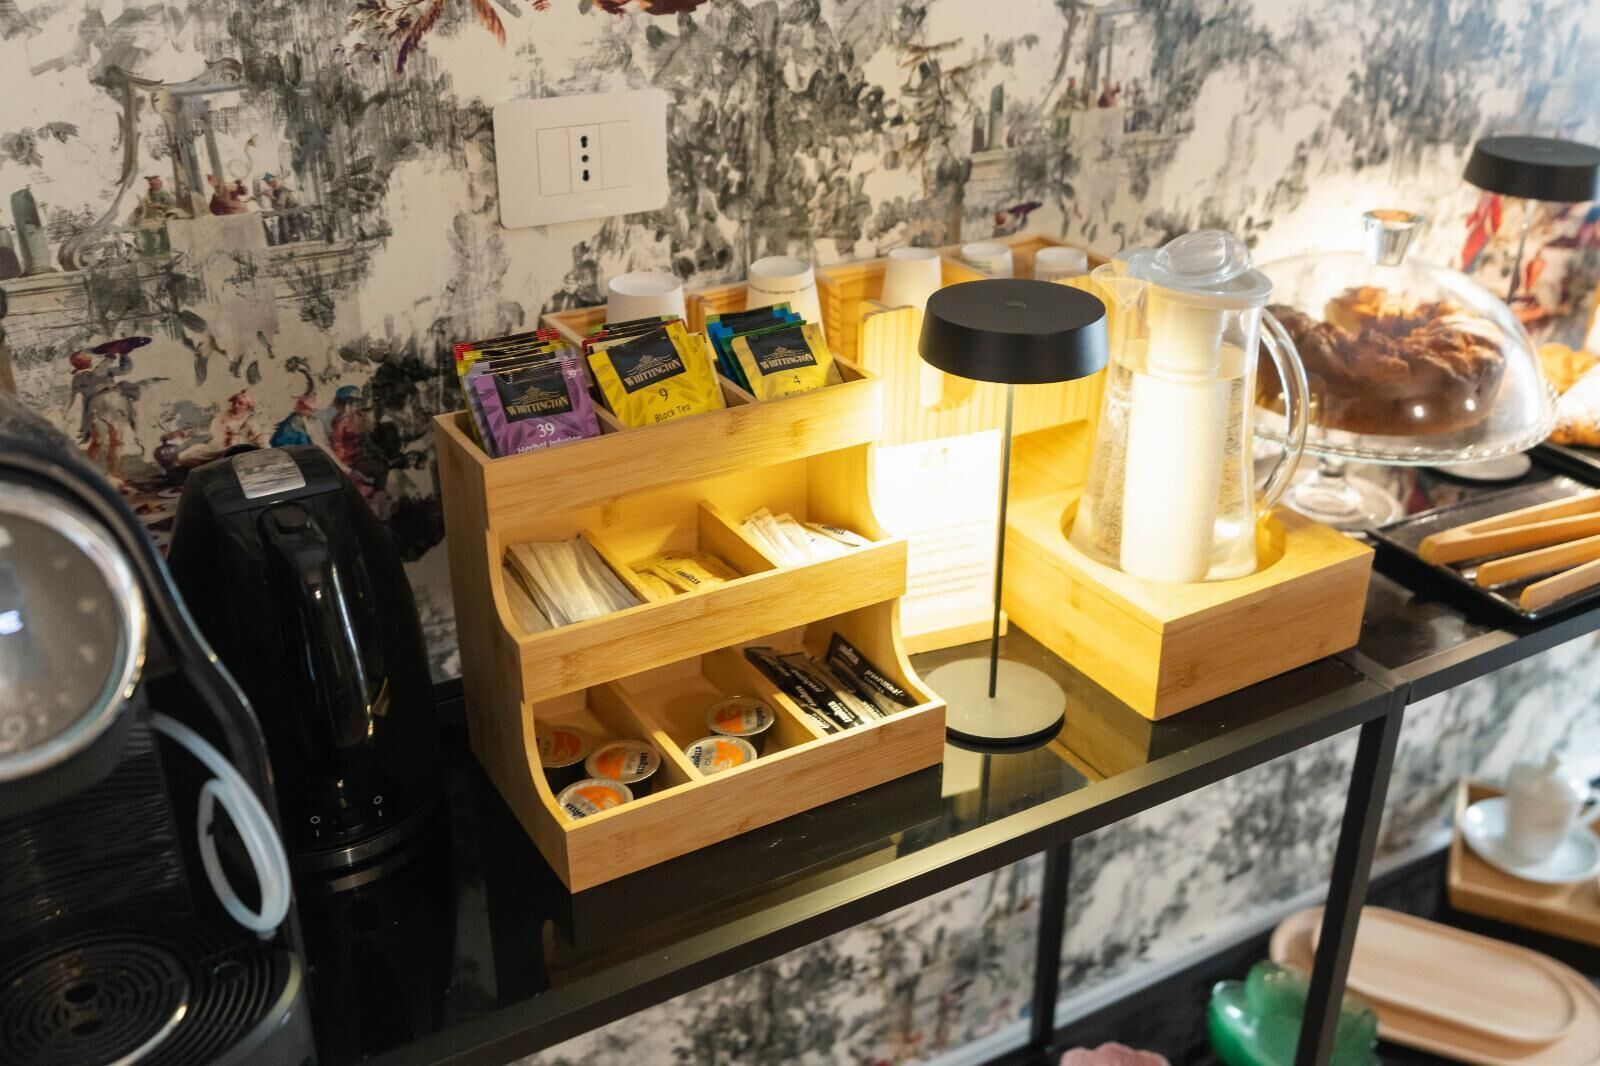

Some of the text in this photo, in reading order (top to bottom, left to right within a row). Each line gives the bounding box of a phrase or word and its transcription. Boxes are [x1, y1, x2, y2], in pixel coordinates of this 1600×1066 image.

[760, 353, 814, 370] WHITTINGTON
[566, 369, 577, 380] 39
[623, 358, 682, 387] WHITTINGTON
[793, 375, 801, 384] 4
[658, 388, 669, 402] 9
[506, 395, 570, 417] WHITTINGTON
[654, 404, 692, 423] Black Tea
[536, 422, 555, 438] 39
[517, 441, 547, 455] Herbal
